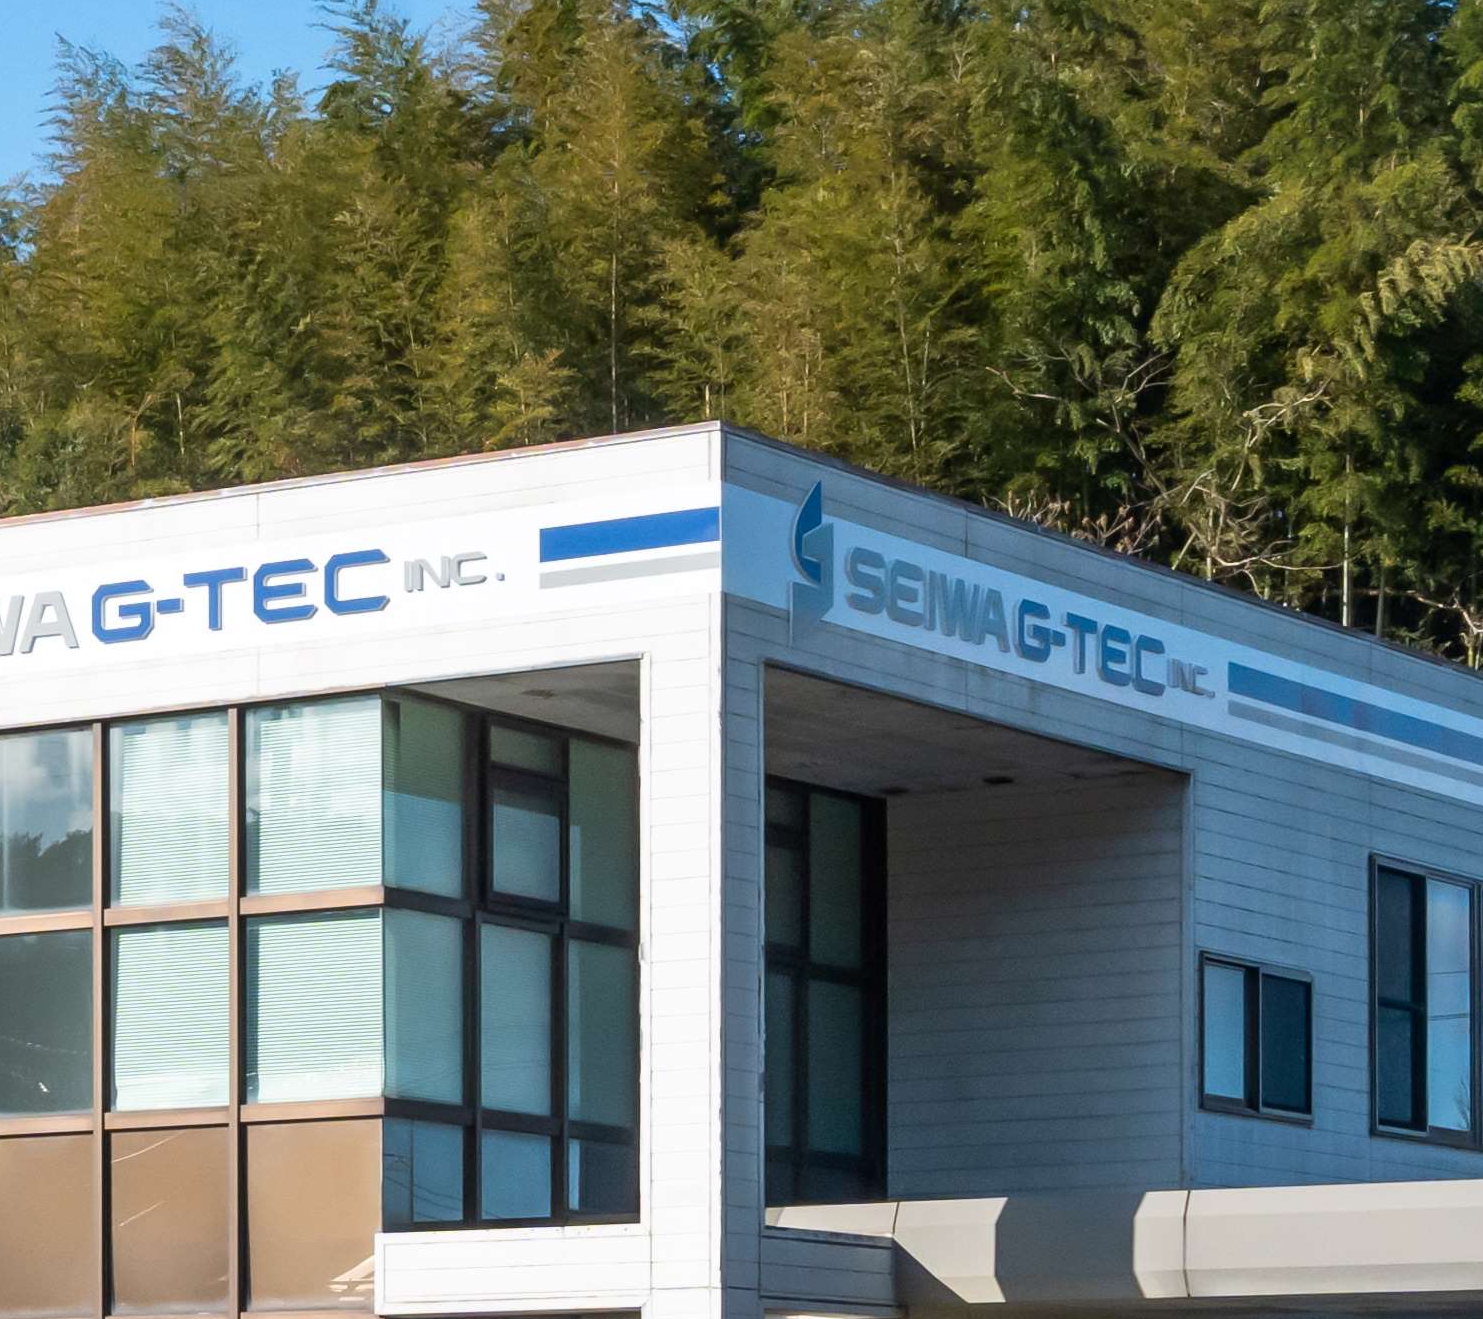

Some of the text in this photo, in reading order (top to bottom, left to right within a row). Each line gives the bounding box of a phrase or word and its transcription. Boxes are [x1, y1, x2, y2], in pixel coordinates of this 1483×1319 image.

[91, 548, 391, 645] G-TEC
[403, 550, 505, 593] INC.
[844, 545, 1216, 699] SEIWA G-TEC INC.
